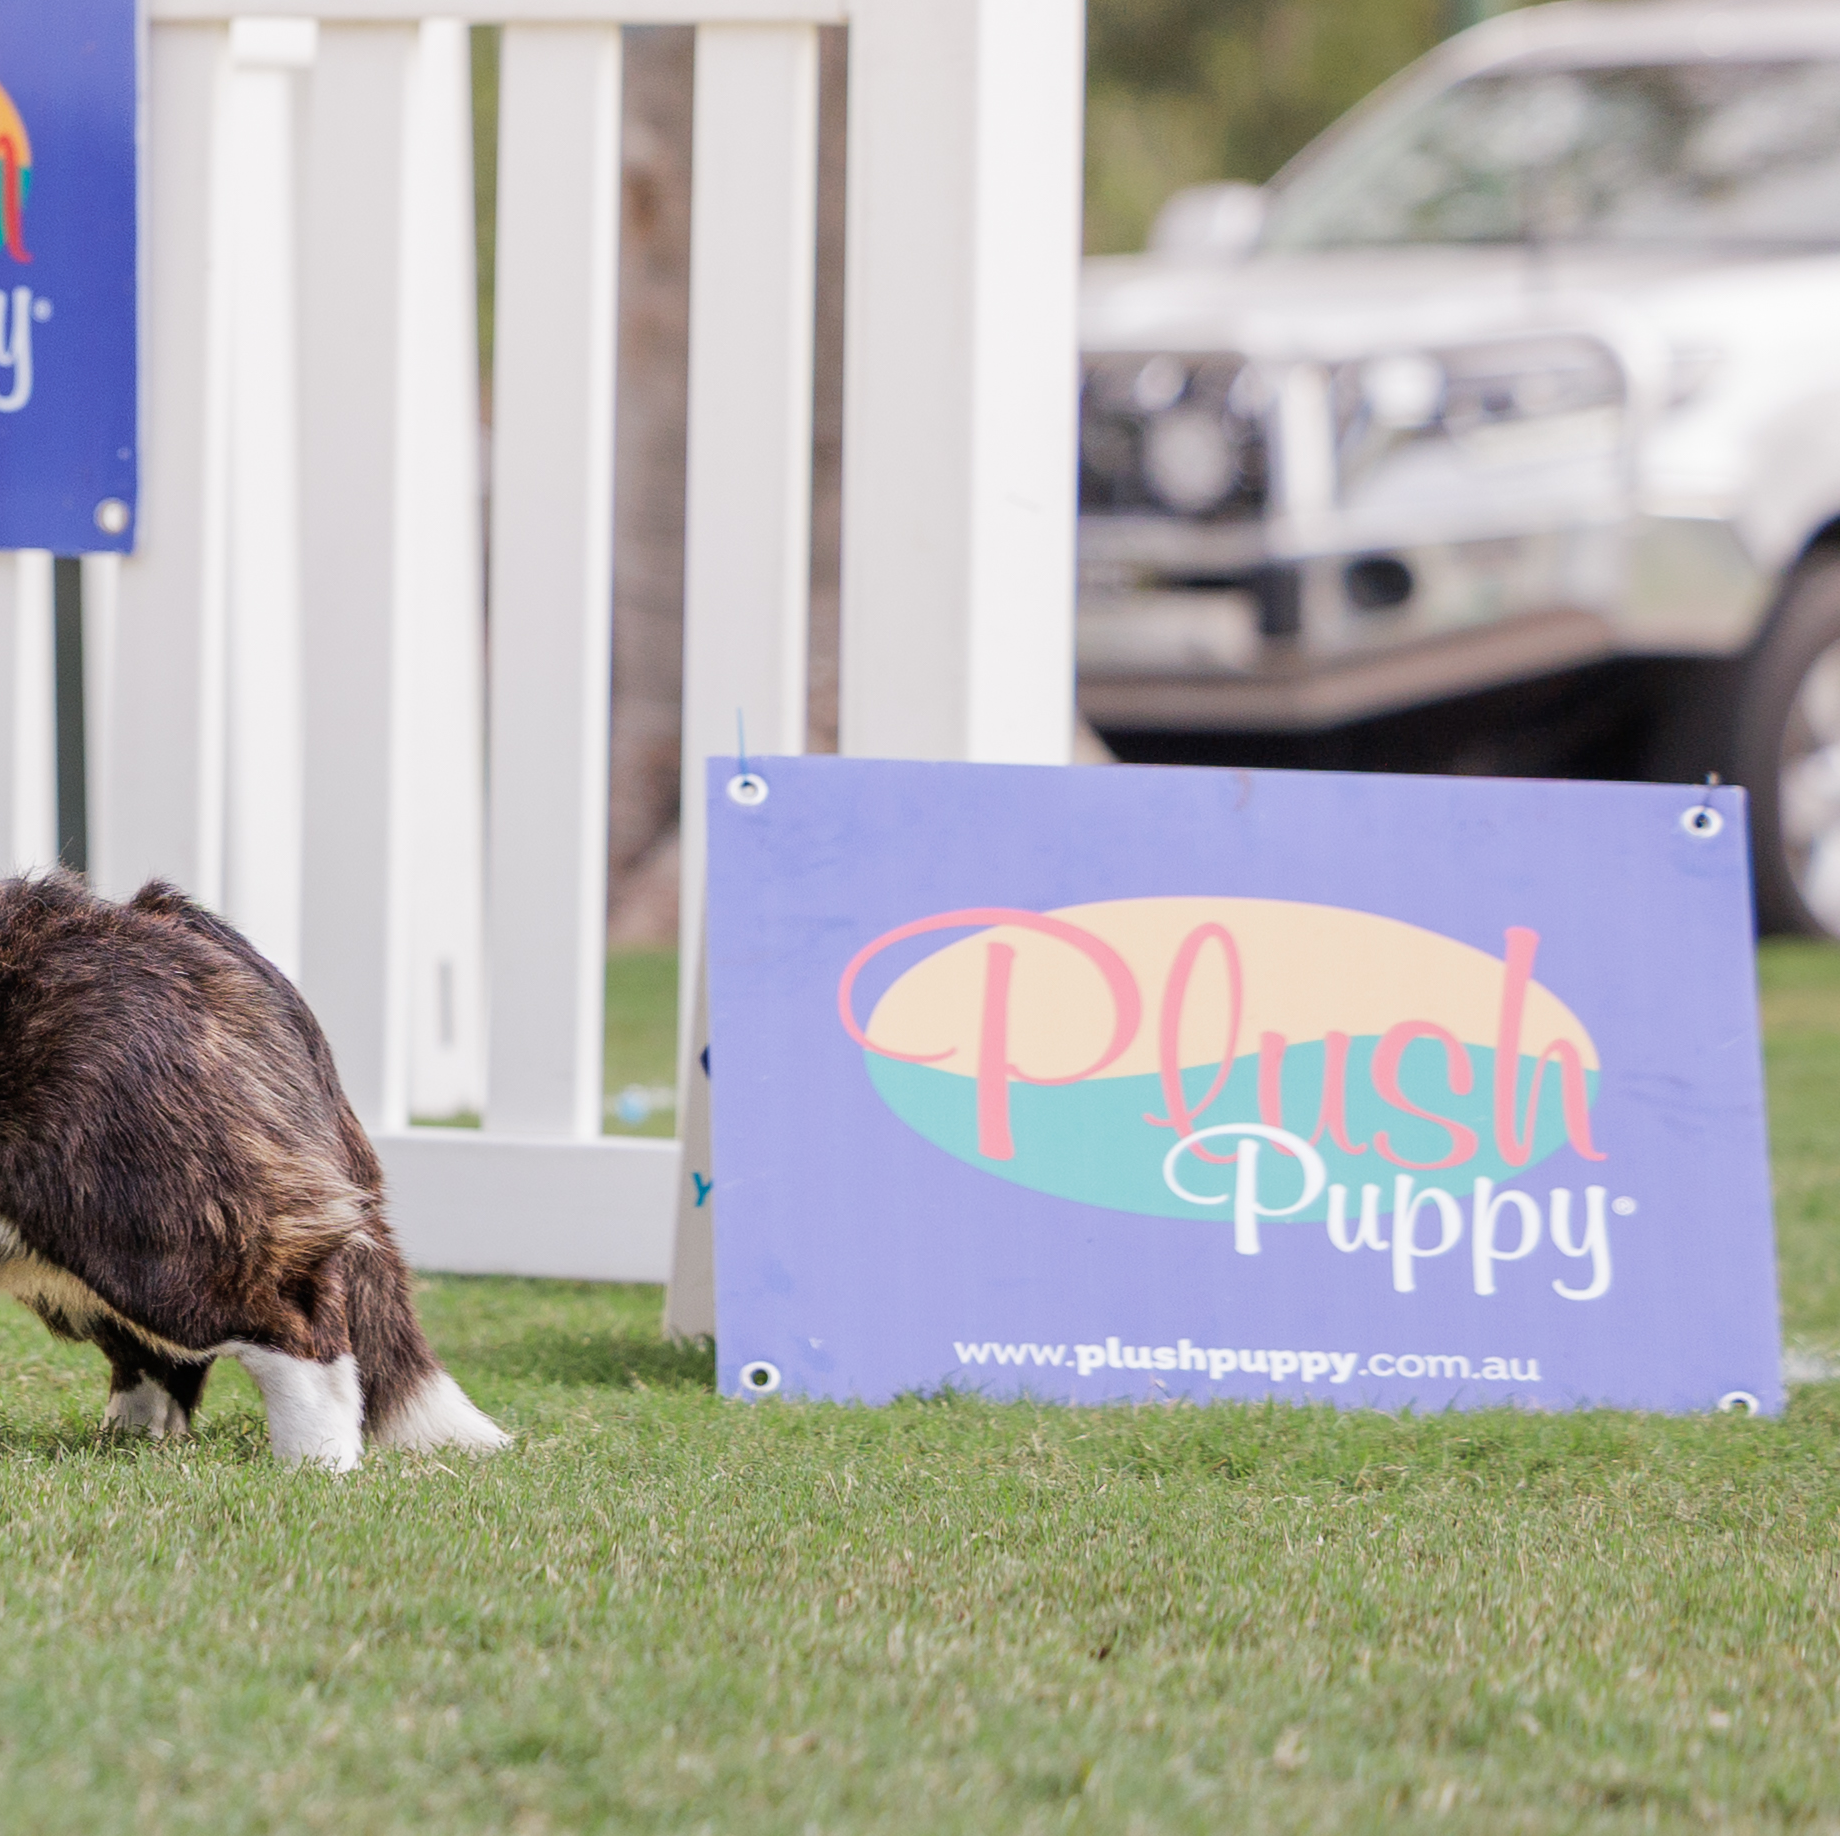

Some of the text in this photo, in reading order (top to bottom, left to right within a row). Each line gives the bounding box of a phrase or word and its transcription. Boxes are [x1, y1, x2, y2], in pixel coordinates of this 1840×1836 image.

[838, 906, 1608, 1171] Plush
[1162, 1122, 1613, 1302] Puppy
[953, 1336, 1542, 1384] www.plushpuppy.com.au
